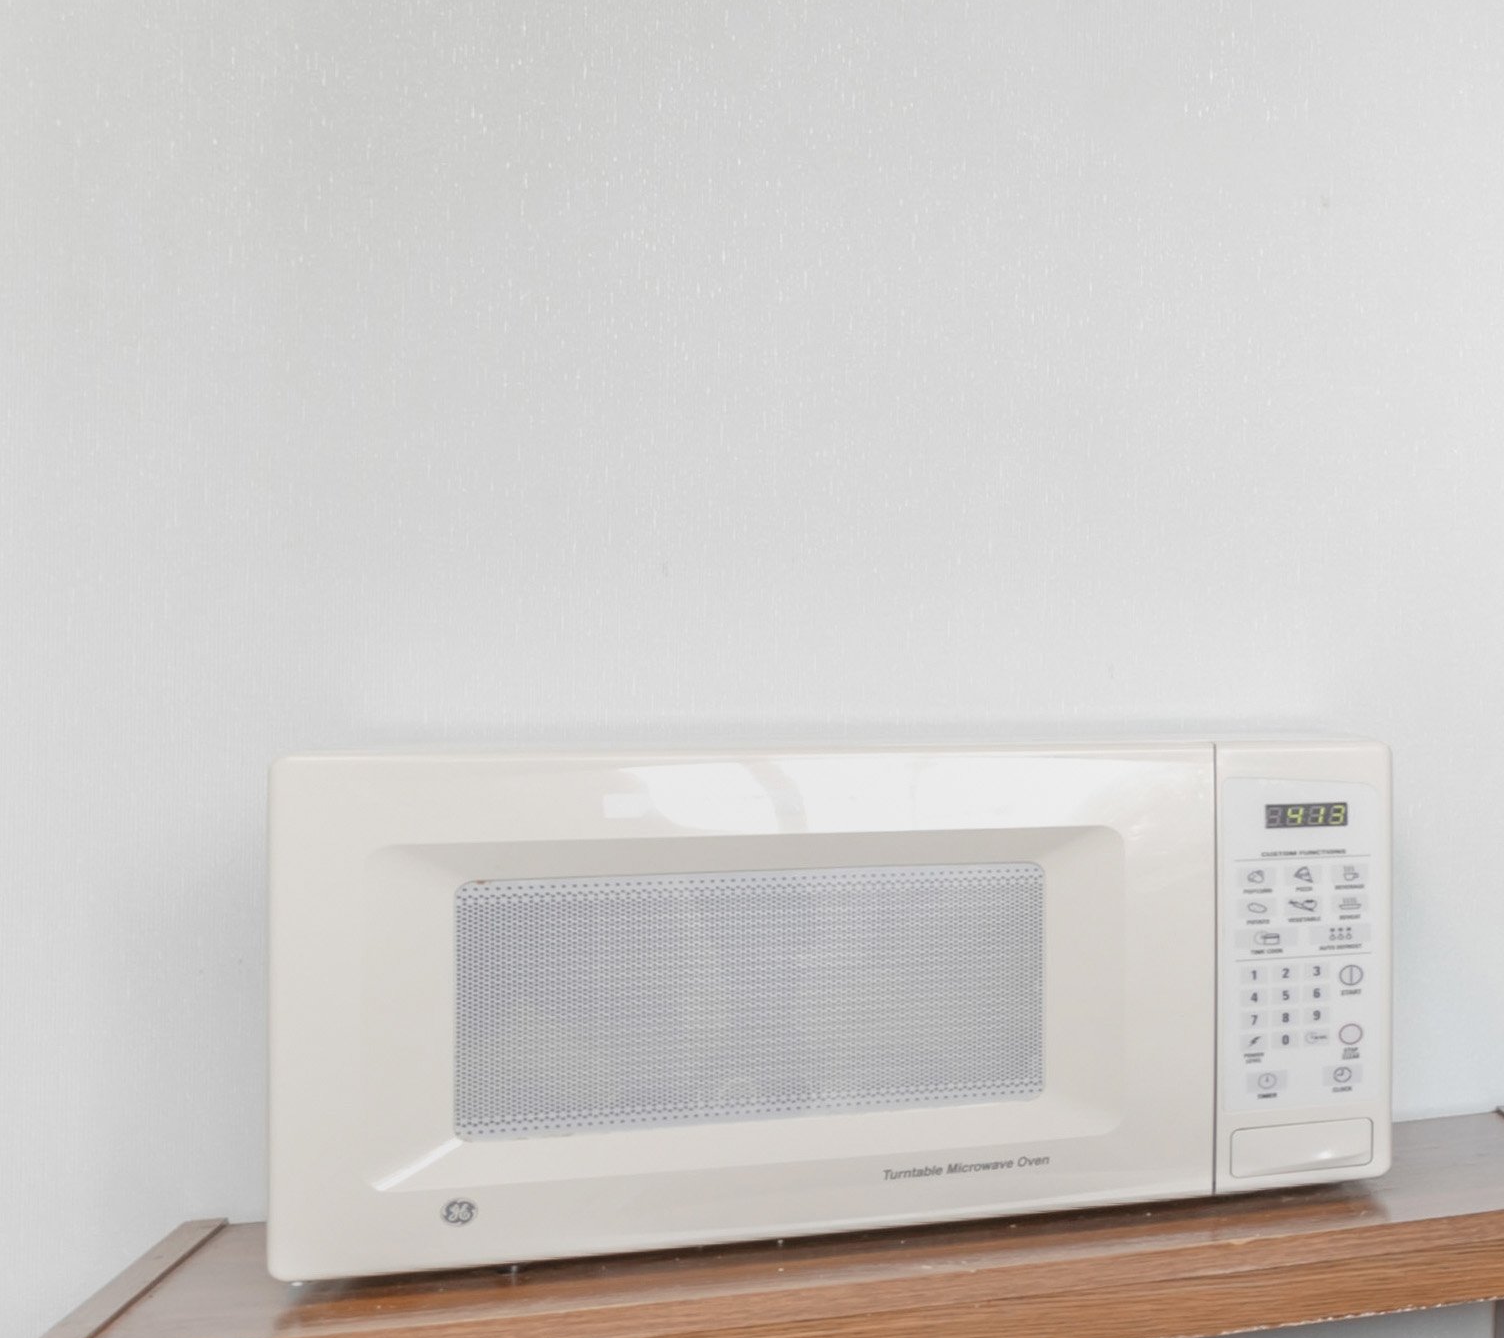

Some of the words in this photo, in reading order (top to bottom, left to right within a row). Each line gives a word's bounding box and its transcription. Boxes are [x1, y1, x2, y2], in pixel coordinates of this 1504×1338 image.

[883, 1165, 943, 1181] Turntable
[946, 1158, 1014, 1175] Microwave
[1017, 1155, 1051, 1168] Oven
